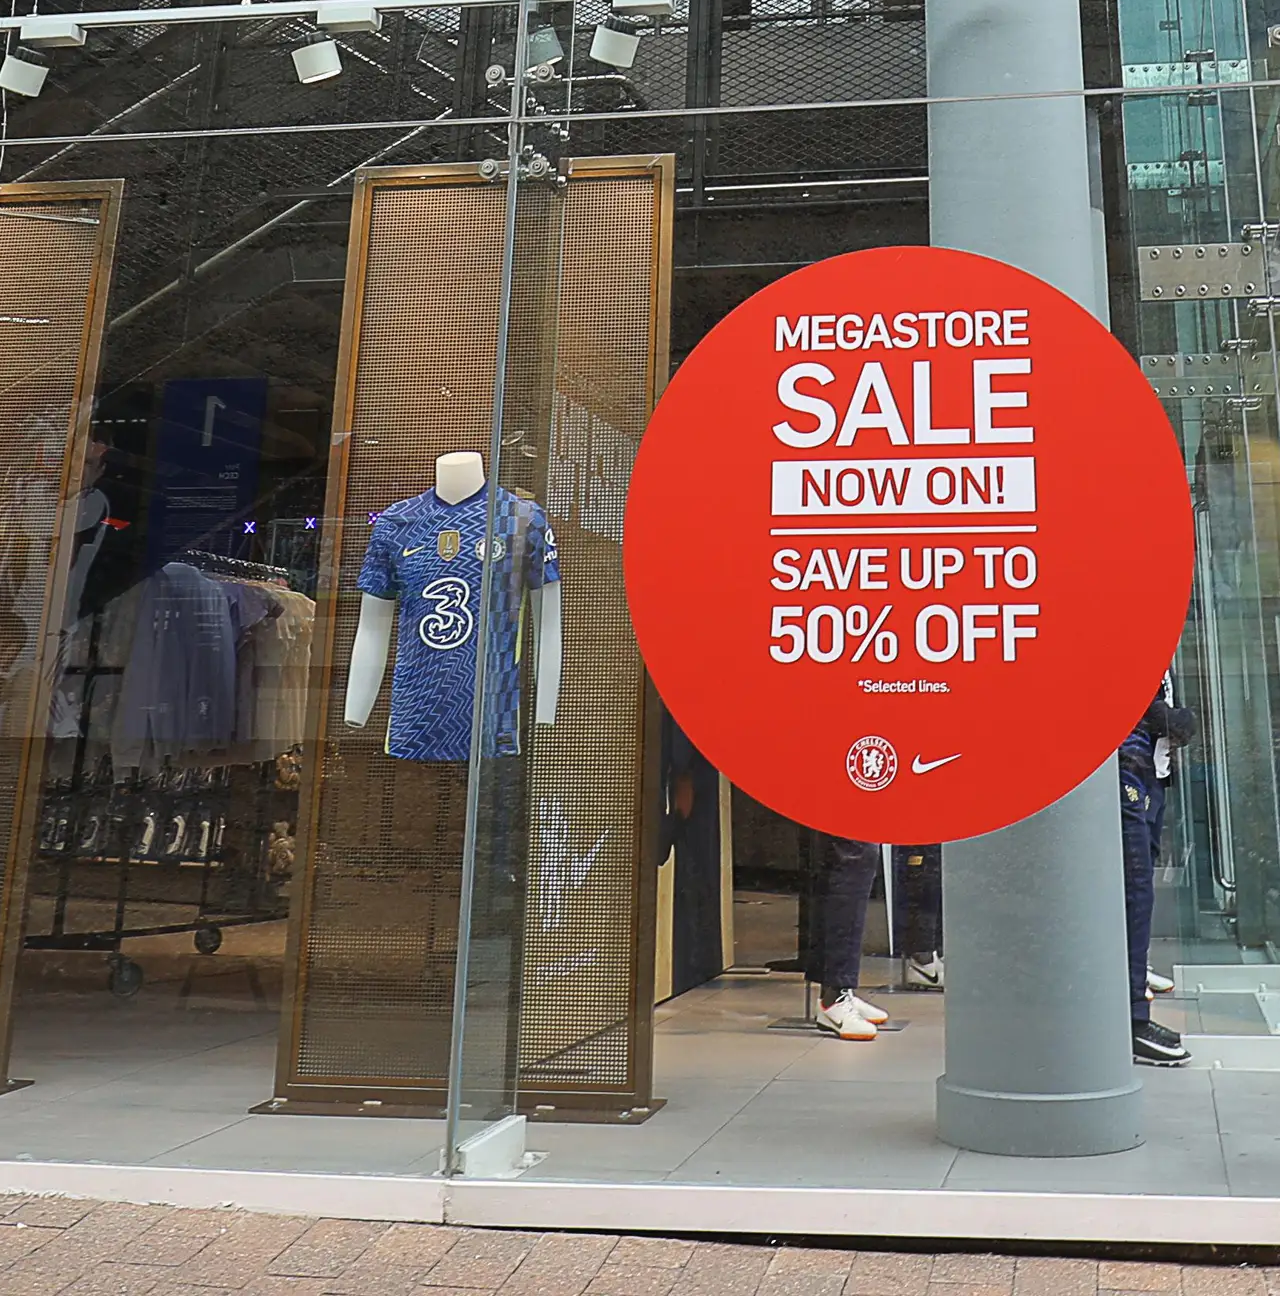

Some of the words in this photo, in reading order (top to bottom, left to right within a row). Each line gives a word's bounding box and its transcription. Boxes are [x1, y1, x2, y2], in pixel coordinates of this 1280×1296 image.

[774, 308, 1031, 351] MEGASTORE
[771, 357, 1035, 448] SALE
[801, 466, 911, 507] NOW
[925, 465, 1005, 505] ON!
[769, 547, 889, 591] SAVE
[901, 548, 965, 589] UP
[974, 545, 1038, 589] TO
[767, 604, 898, 664] 50%
[914, 603, 1041, 662] OFF
[918, 680, 950, 693] lines.
